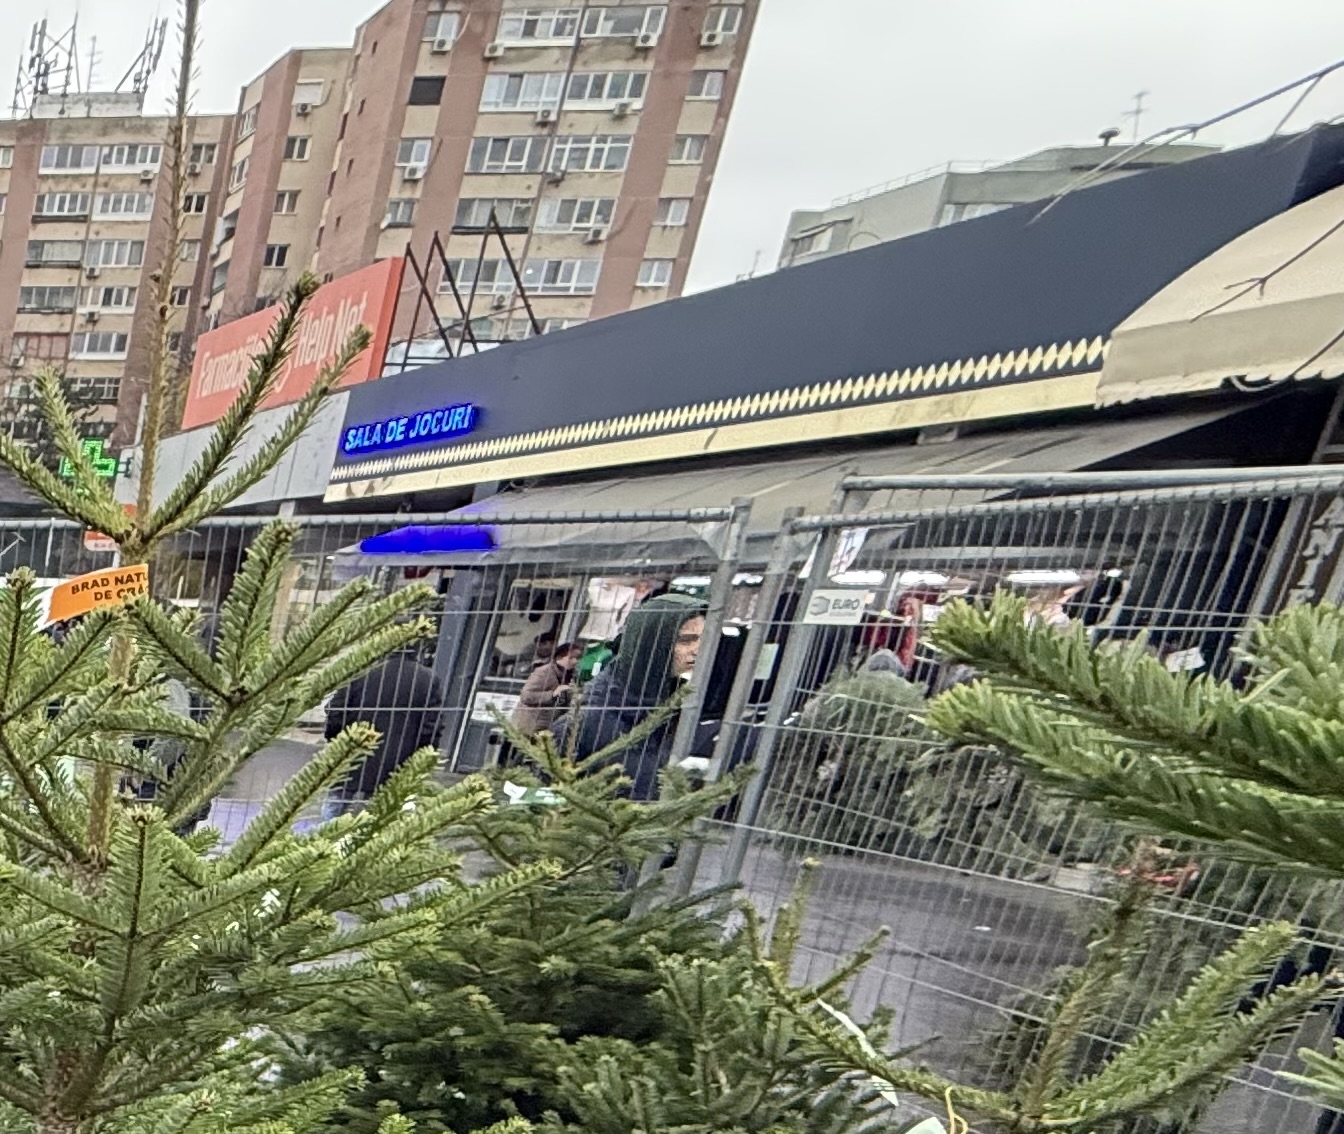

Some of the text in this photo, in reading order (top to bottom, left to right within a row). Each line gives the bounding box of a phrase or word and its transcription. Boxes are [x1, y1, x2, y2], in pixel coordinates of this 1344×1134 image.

[294, 306, 335, 371] Help
[345, 404, 472, 452] SALA DE JOCURI
[71, 577, 110, 595] BRAD
[94, 590, 113, 601] DE
[831, 598, 861, 610] EURO
